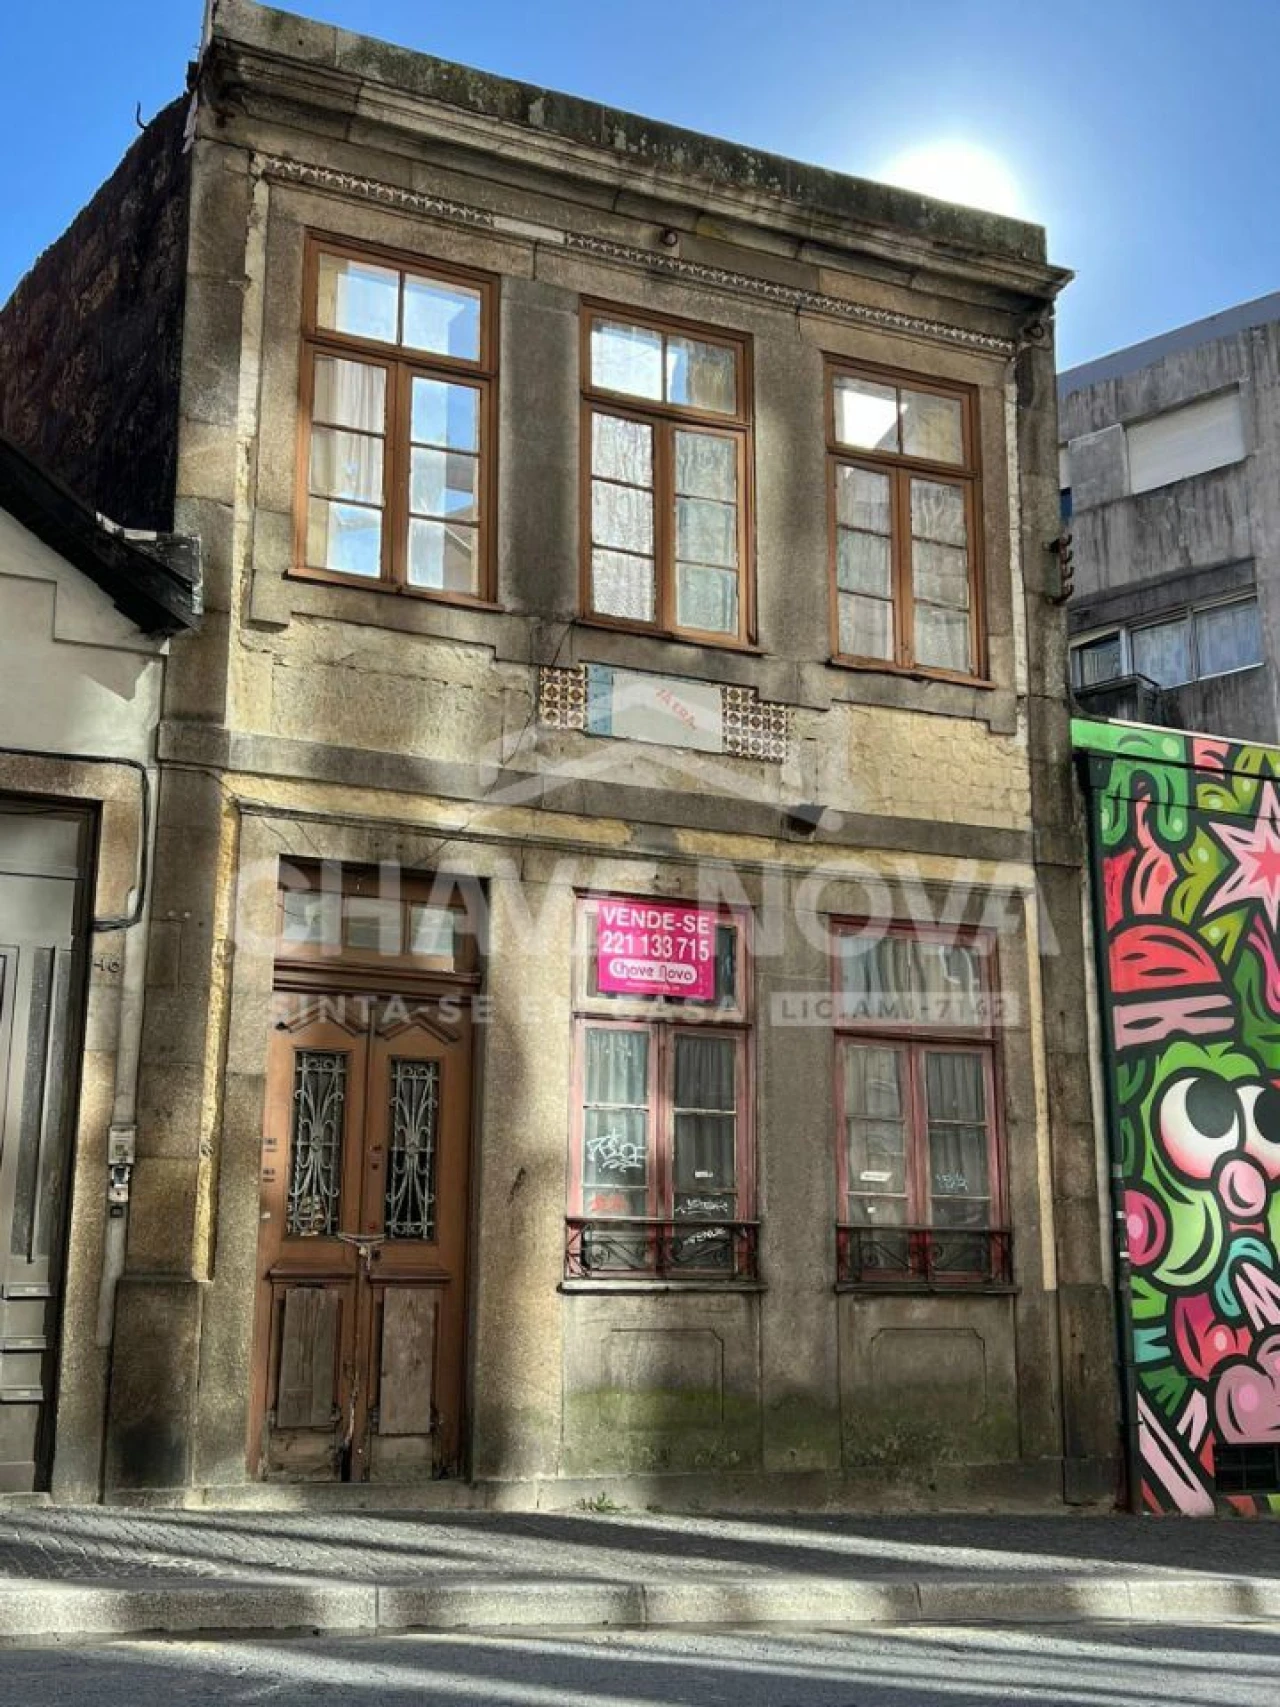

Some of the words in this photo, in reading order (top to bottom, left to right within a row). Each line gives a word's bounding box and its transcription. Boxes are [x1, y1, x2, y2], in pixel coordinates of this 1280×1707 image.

[602, 906, 710, 934] VENDE-SE
[602, 929, 634, 954] 221
[639, 934, 673, 959] 133
[676, 937, 710, 962] 715
